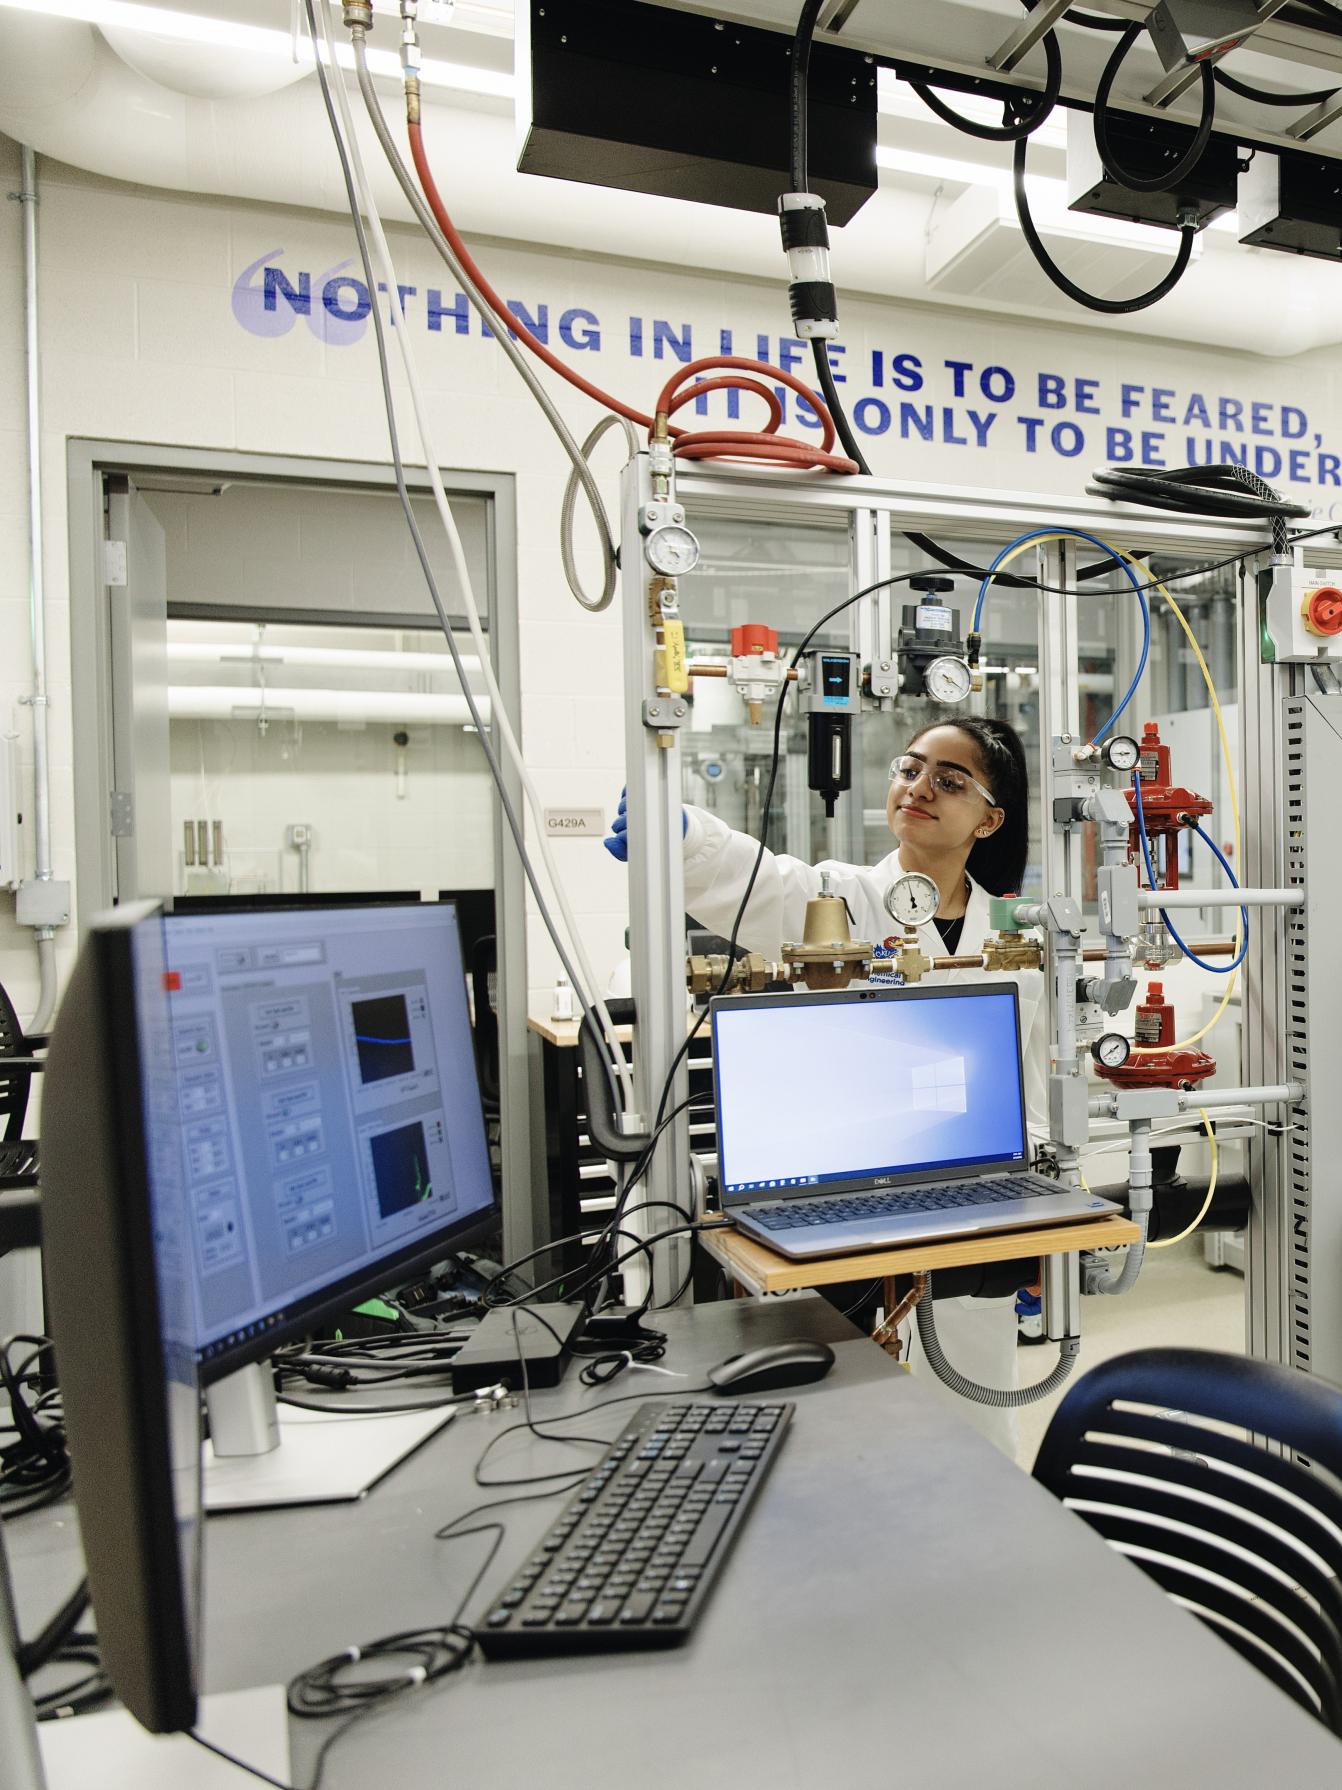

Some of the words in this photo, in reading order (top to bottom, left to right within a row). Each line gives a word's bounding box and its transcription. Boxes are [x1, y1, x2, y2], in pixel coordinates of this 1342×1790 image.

[629, 316, 692, 363] IN
[871, 349, 924, 392] IS
[944, 360, 1015, 403] TO
[1038, 372, 1100, 415] BE
[1120, 383, 1324, 449] FEARED,
[853, 397, 998, 448] ONLY
[1017, 416, 1085, 457] TO
[1105, 426, 1166, 466] BE
[548, 818, 586, 828] G429A
[867, 975, 905, 986] ngineering
